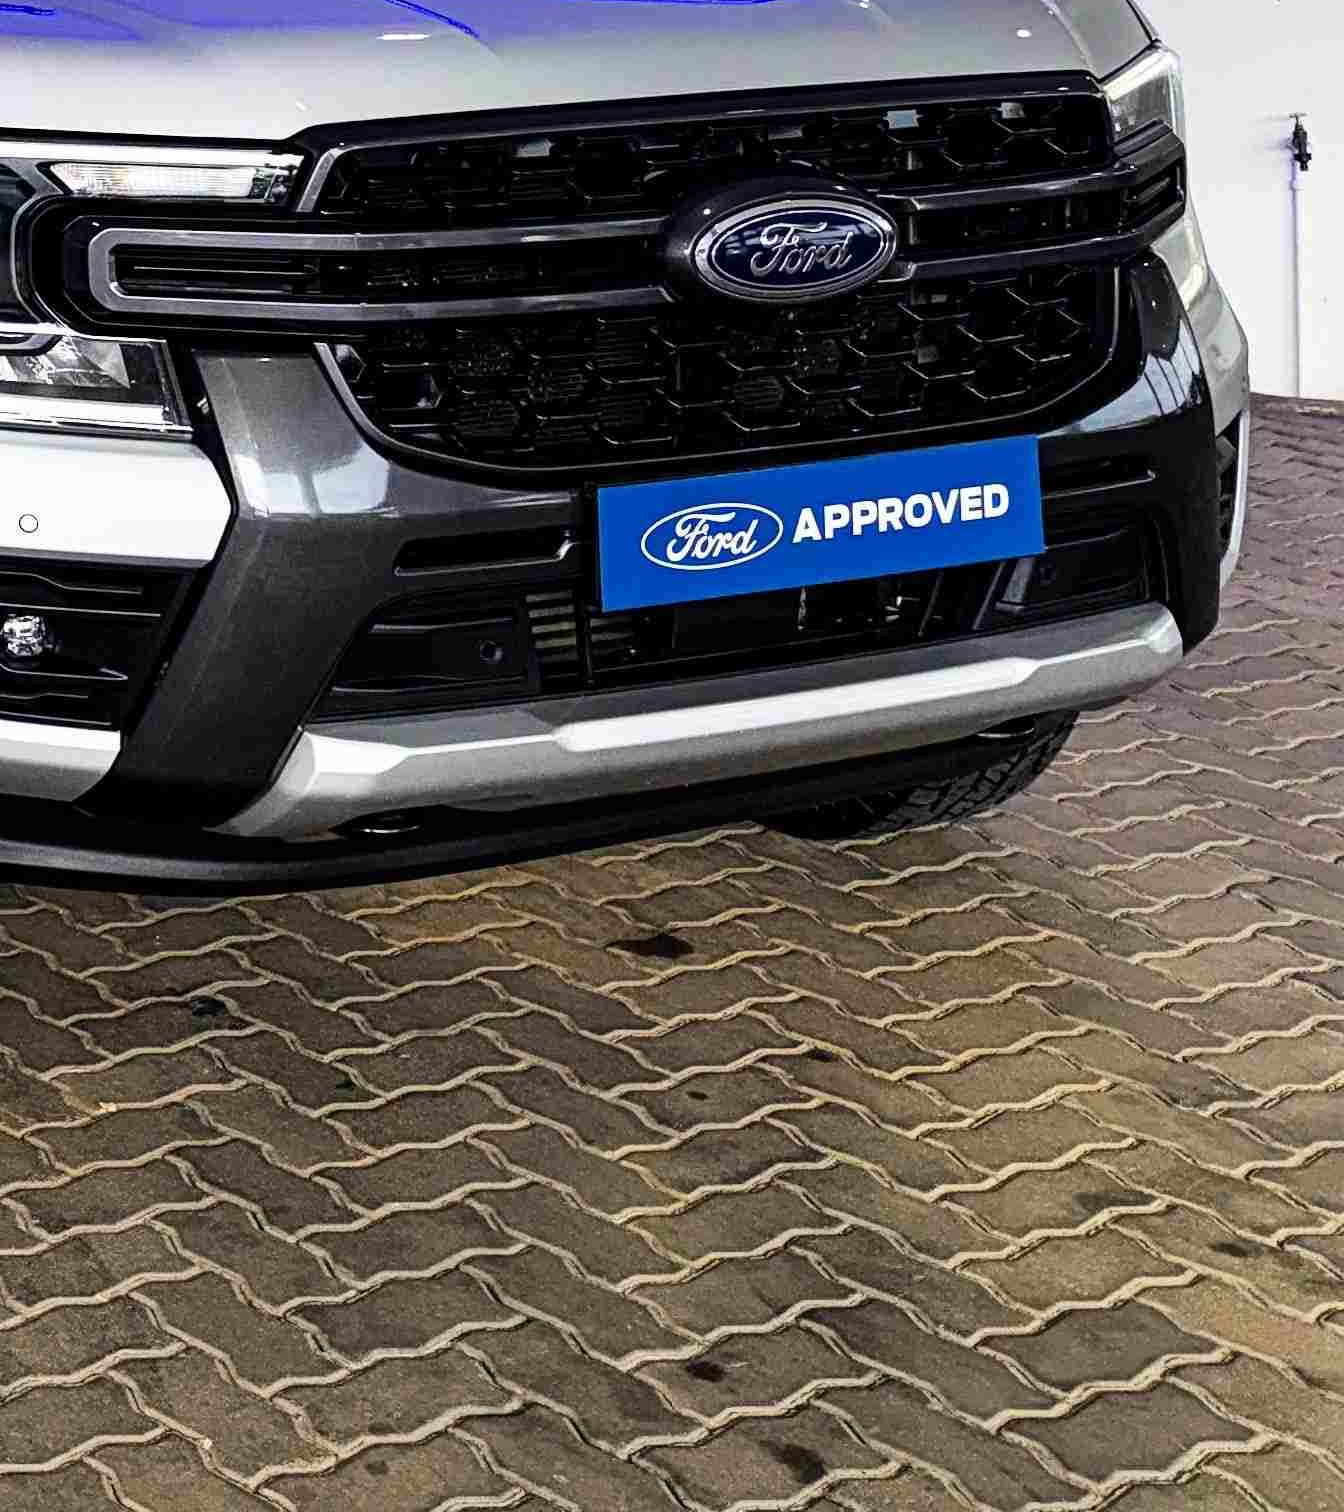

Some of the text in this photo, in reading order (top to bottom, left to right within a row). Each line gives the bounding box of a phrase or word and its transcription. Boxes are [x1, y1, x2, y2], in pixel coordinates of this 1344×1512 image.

[751, 222, 854, 277] Ford
[667, 483, 1010, 562] Ford APPROVED
